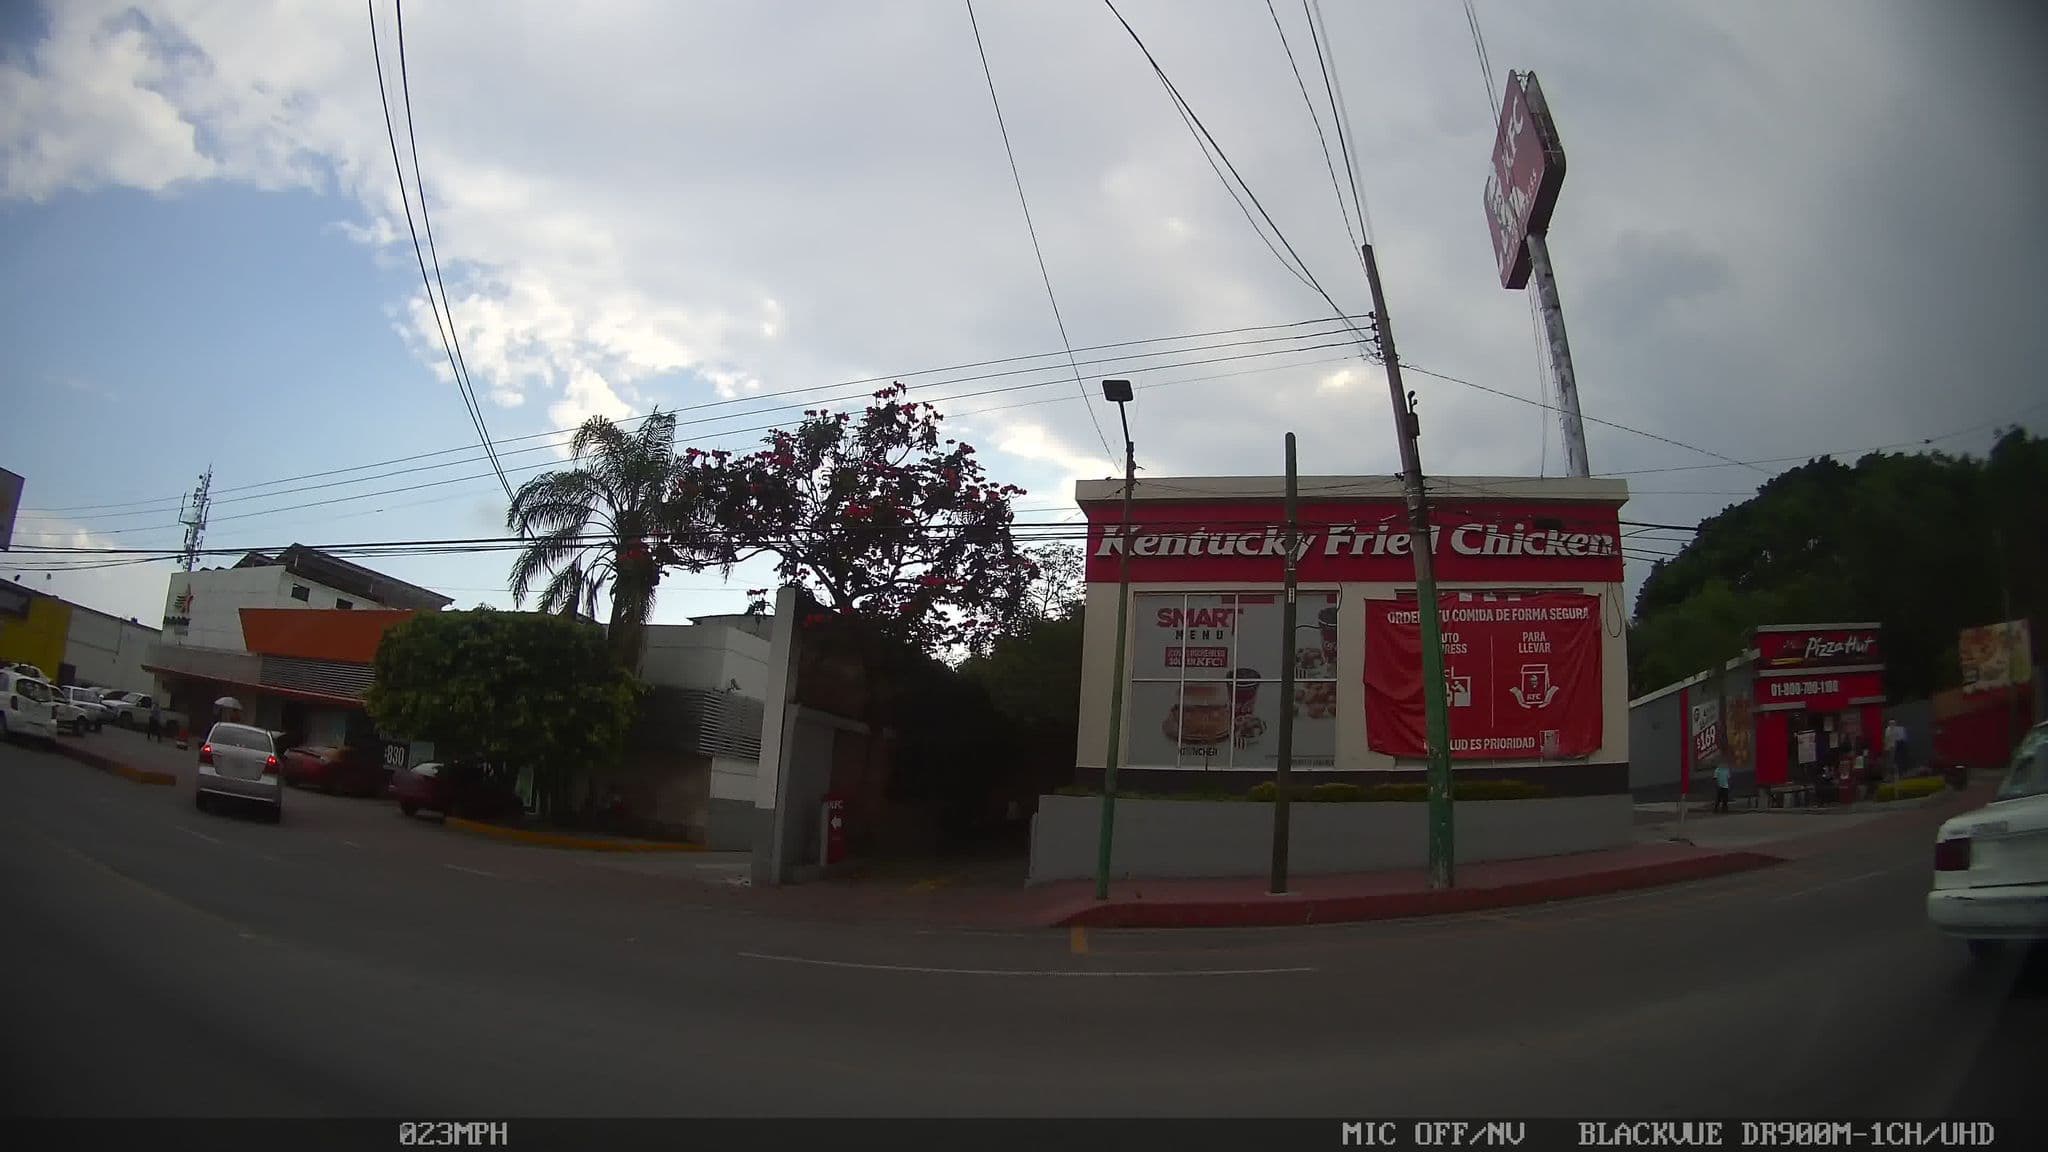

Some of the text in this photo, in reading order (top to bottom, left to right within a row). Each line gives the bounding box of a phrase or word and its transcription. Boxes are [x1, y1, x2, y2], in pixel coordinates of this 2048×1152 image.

[1094, 525, 1316, 562] Kentucky
[1450, 523, 1613, 556] Chicken
[1157, 608, 1244, 629] SMART
[1452, 608, 1494, 622] COMIDA
[1496, 608, 1510, 622] DE
[1512, 607, 1547, 621] FORMA
[1550, 605, 1589, 620] SEGURA
[1175, 630, 1223, 640] MENU
[1441, 631, 1546, 643] UTO PARA
[1518, 642, 1551, 654] LLEVAR
[1804, 633, 1876, 660] Pizza Hut
[1470, 738, 1483, 751] ES
[1483, 736, 1536, 751] PRIORIDAD
